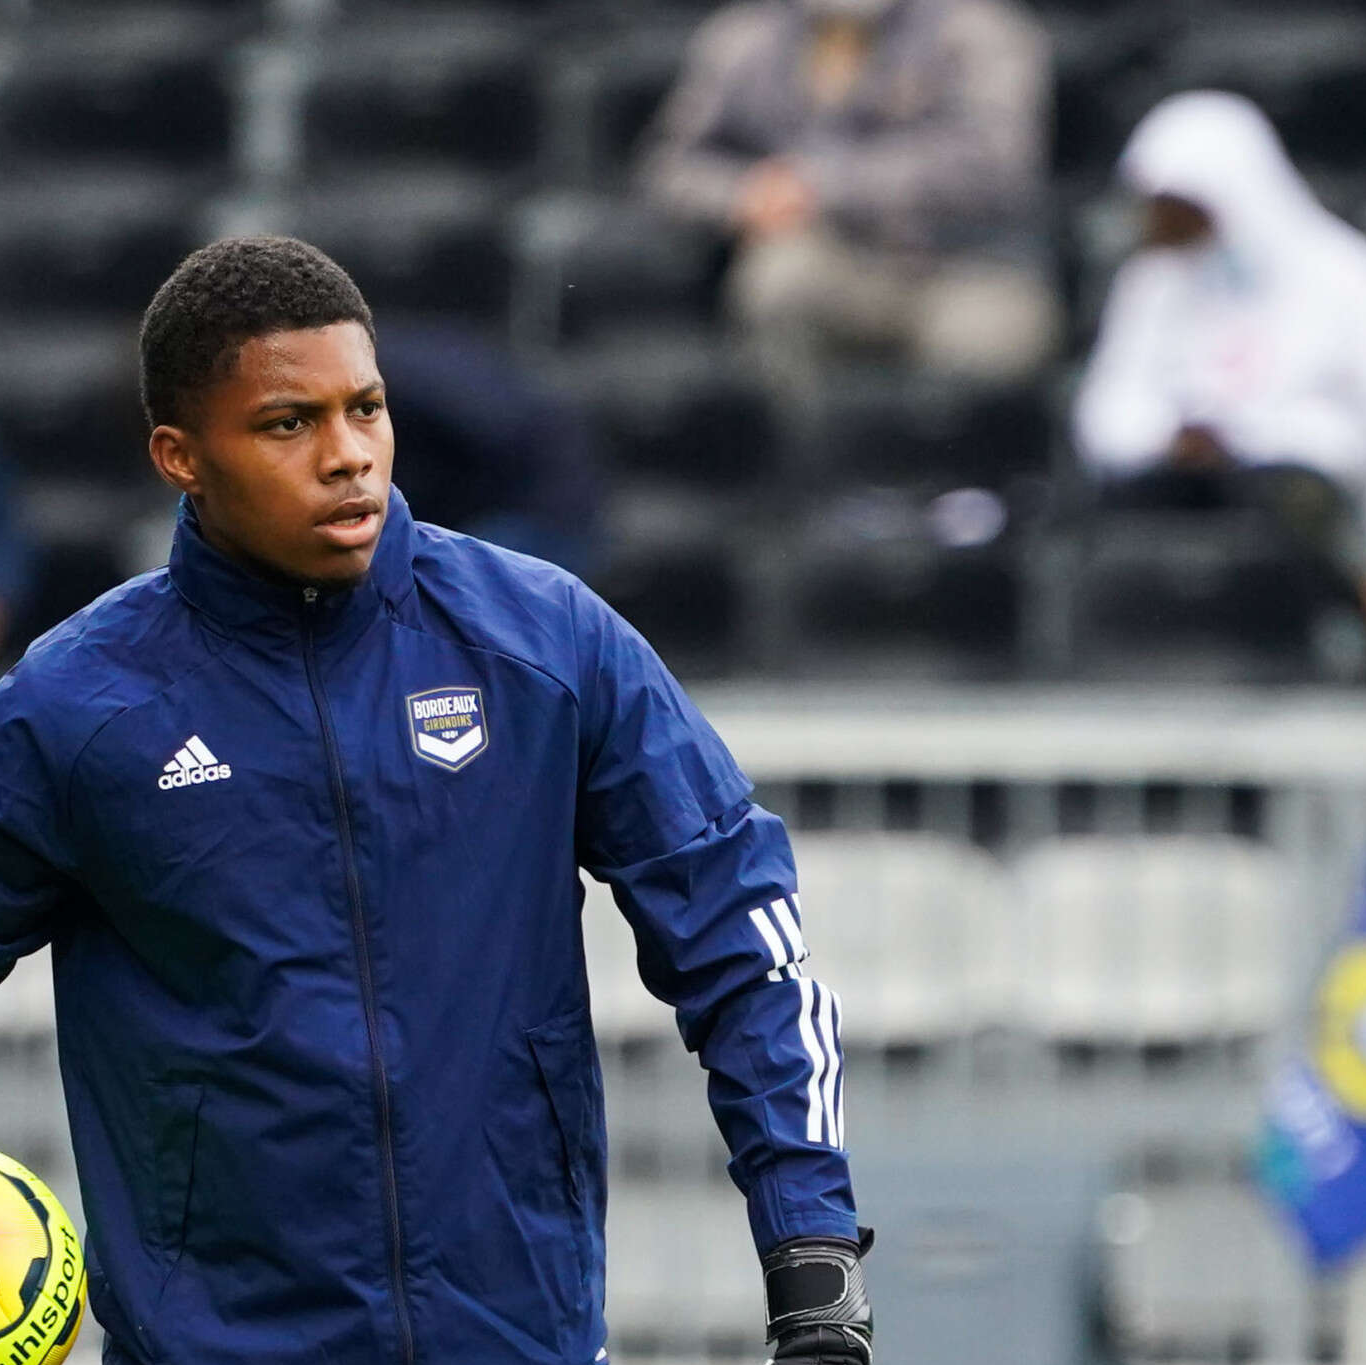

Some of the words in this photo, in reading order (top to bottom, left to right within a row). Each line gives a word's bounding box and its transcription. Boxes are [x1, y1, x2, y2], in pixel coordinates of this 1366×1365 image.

[414, 694, 478, 719] BORDEAUX
[424, 714, 473, 731] GIRONDINS
[158, 764, 232, 790] adidas
